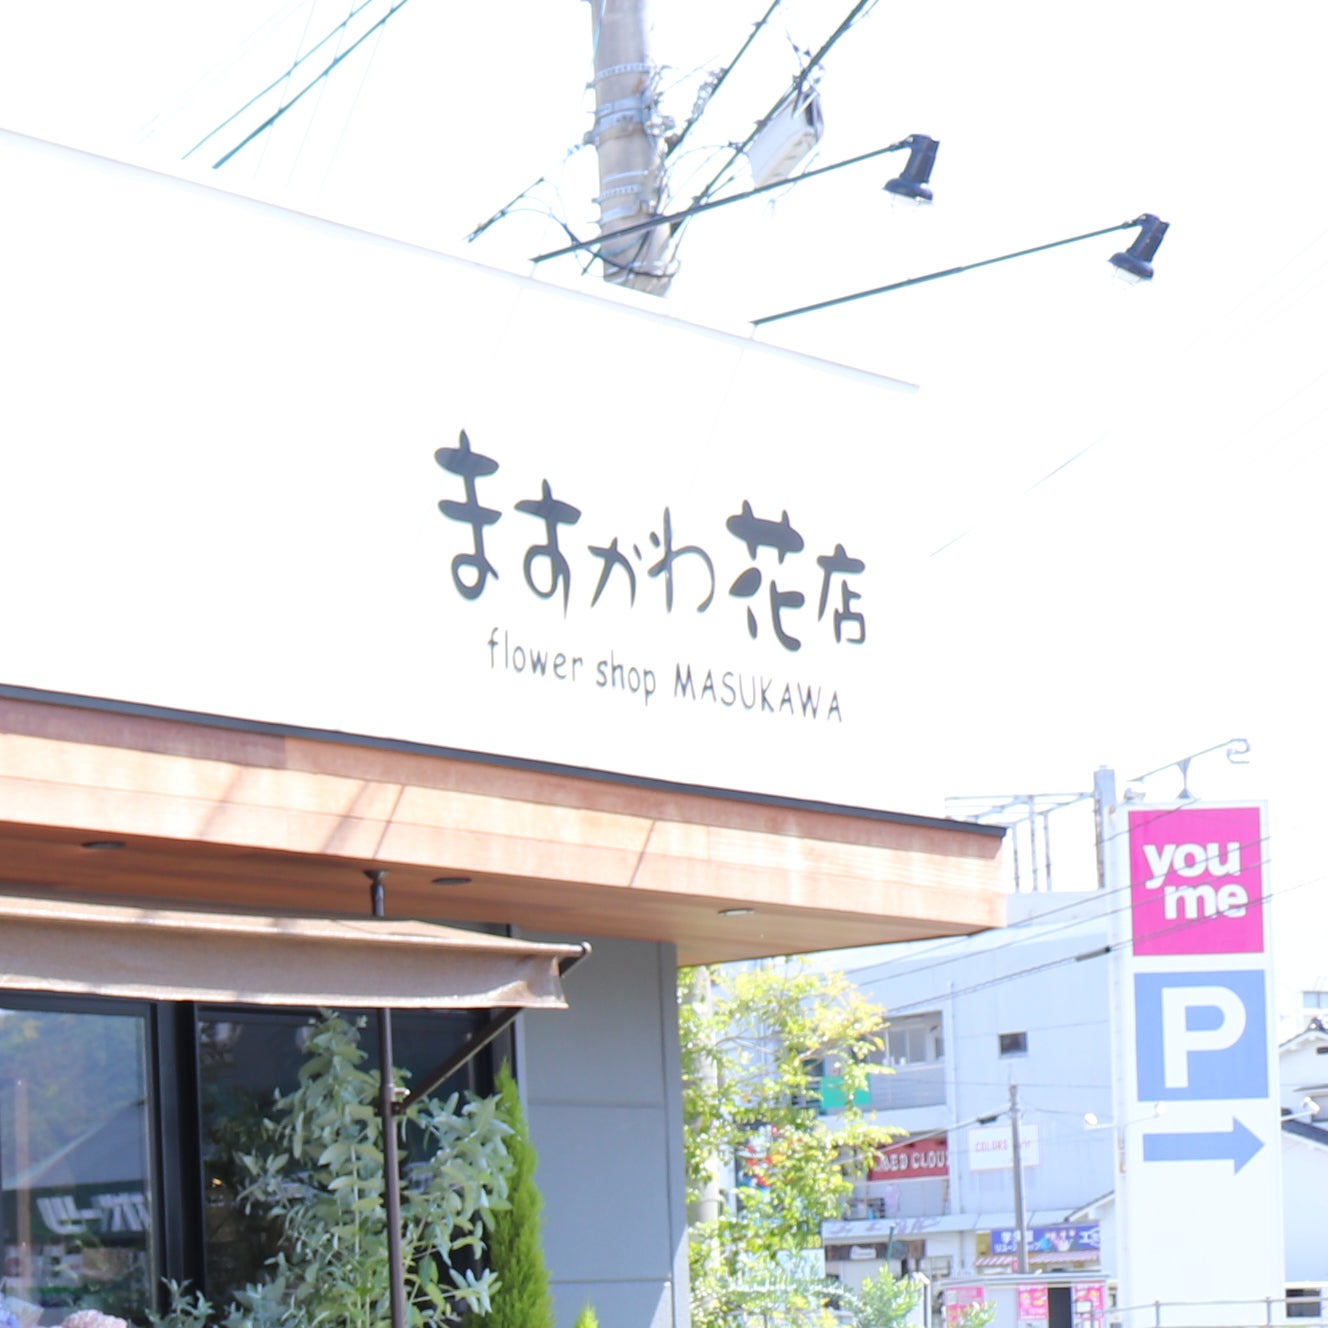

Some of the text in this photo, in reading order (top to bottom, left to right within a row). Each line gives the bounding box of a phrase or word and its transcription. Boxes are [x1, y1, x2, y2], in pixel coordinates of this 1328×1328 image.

[487, 626, 842, 723] flower shop MASUKAWA
[1143, 841, 1240, 889] you
[1164, 883, 1249, 921] me
[1161, 985, 1246, 1088] P
[911, 1150, 948, 1168] CLOU
